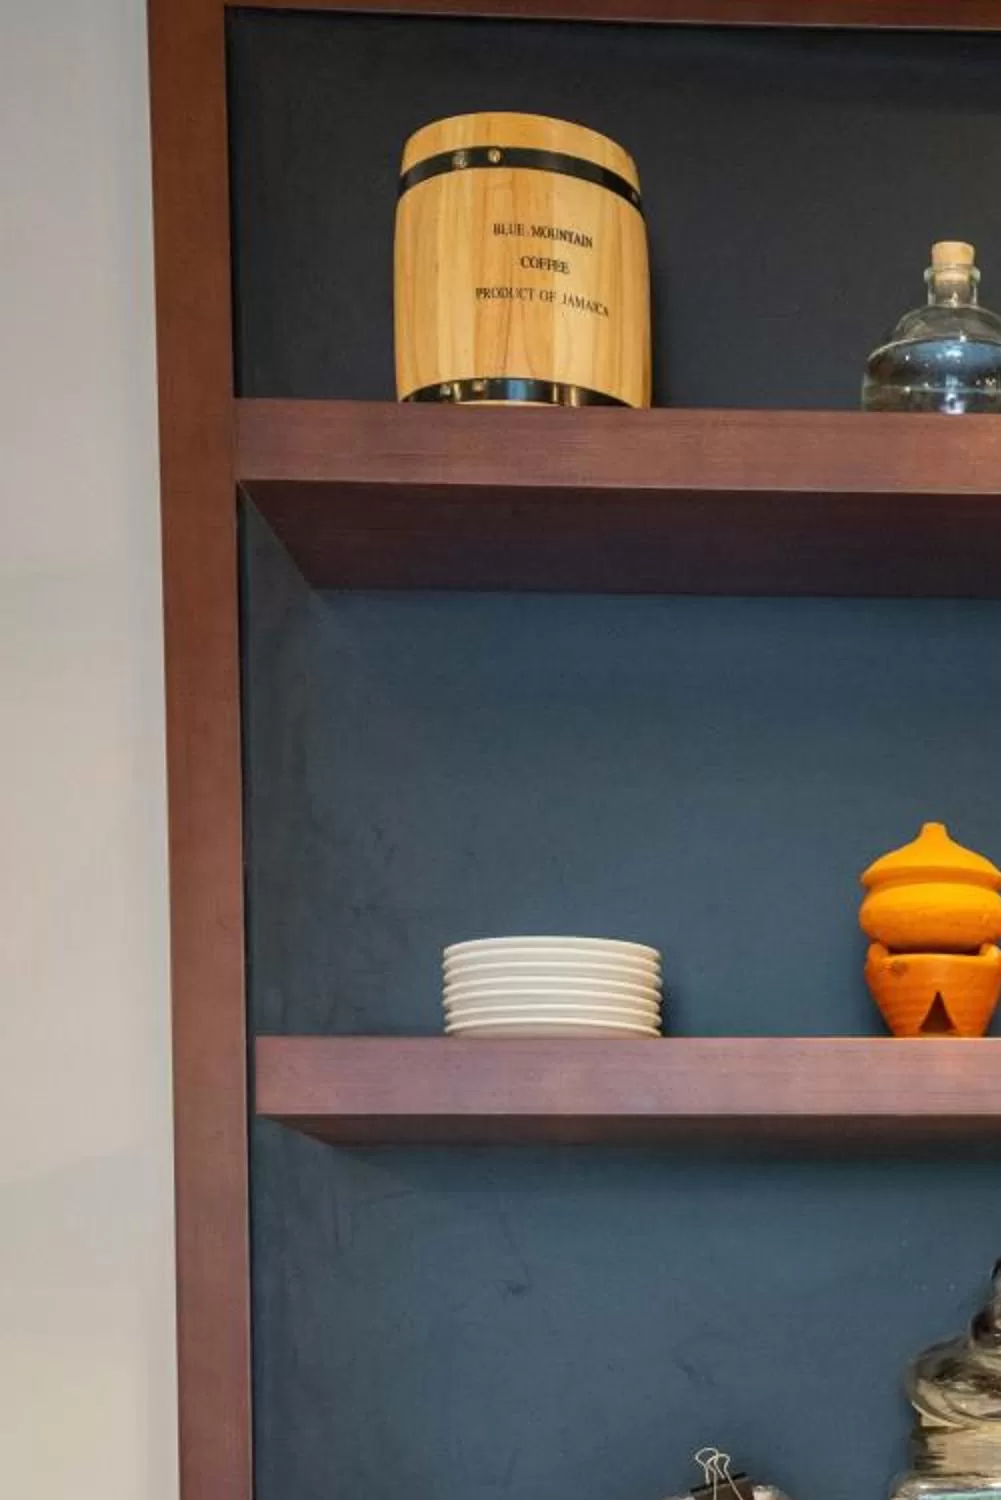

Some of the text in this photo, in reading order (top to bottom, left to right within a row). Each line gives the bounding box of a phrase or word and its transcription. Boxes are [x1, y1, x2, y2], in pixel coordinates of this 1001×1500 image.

[493, 223, 593, 249] BLUE MOUNTAIN
[520, 255, 570, 275] COFFEE
[475, 287, 608, 317] PRODUCT OF JAMAICA
